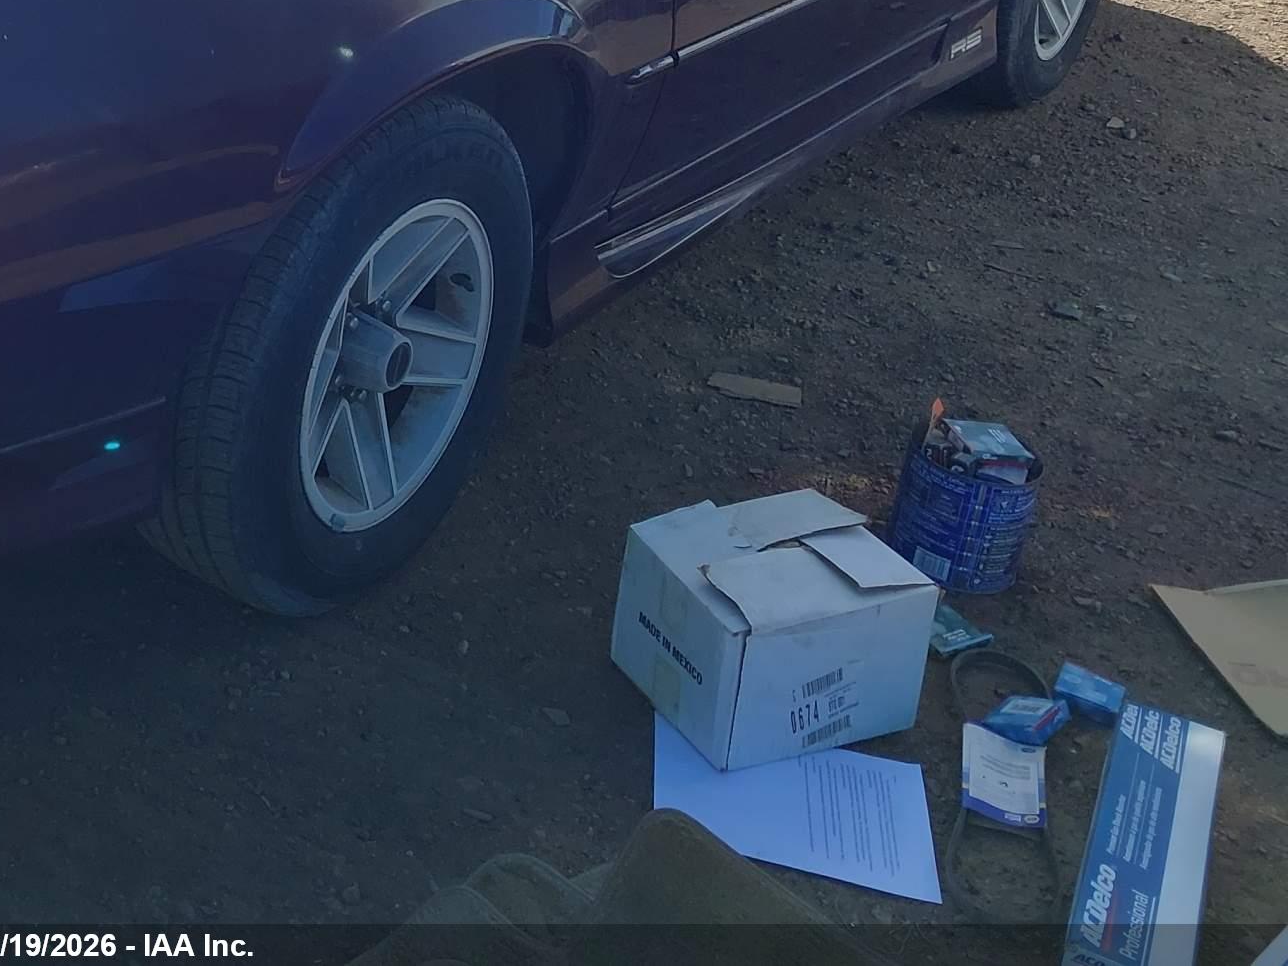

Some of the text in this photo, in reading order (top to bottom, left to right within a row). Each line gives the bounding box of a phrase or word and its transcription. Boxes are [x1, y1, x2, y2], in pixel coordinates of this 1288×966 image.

[638, 611, 703, 686] MADE IN MEXICO
[790, 699, 820, 734] 0674
[1160, 716, 1182, 771] ACDelco
[1079, 863, 1116, 948] ACDelco
[1119, 889, 1149, 960] Professional
